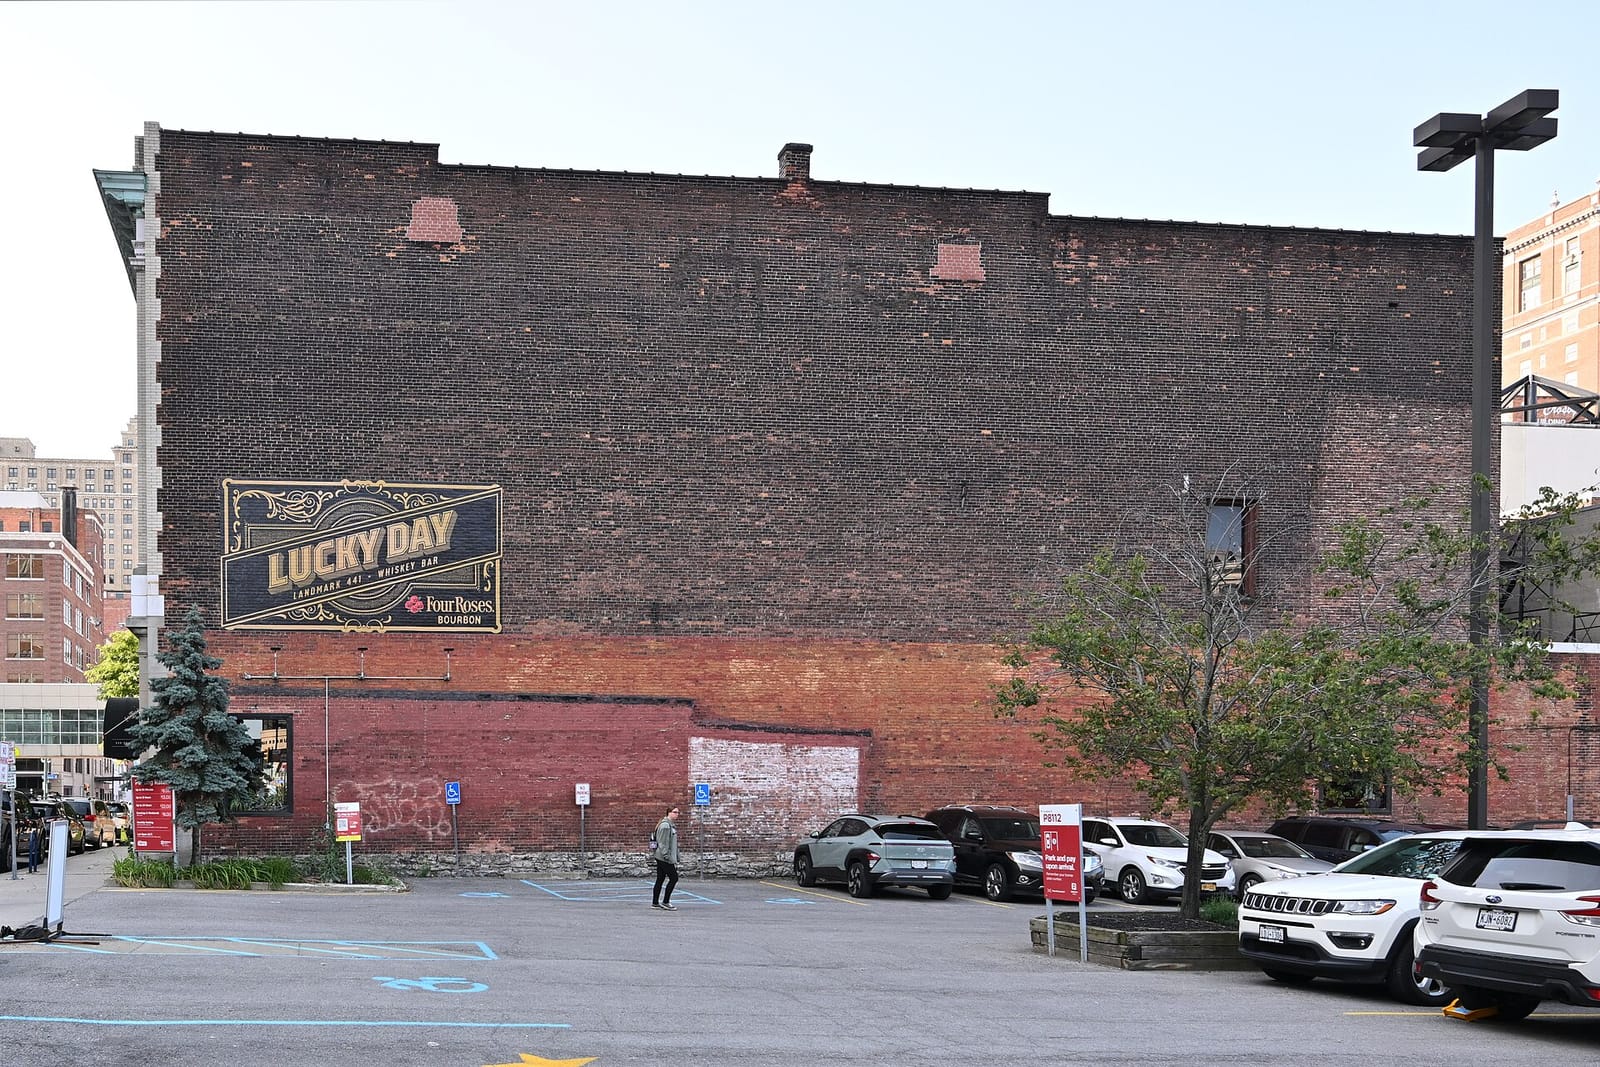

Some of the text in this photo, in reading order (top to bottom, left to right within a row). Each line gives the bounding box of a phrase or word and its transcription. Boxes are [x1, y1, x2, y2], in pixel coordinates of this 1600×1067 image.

[267, 509, 458, 595] LUCKY DAY
[293, 556, 439, 600] LANDMARK 441 WHISKEY BAR
[426, 595, 455, 612] Four
[437, 615, 481, 625] BOURBON
[1043, 813, 1062, 823] P8112
[1045, 854, 1056, 862] Park
